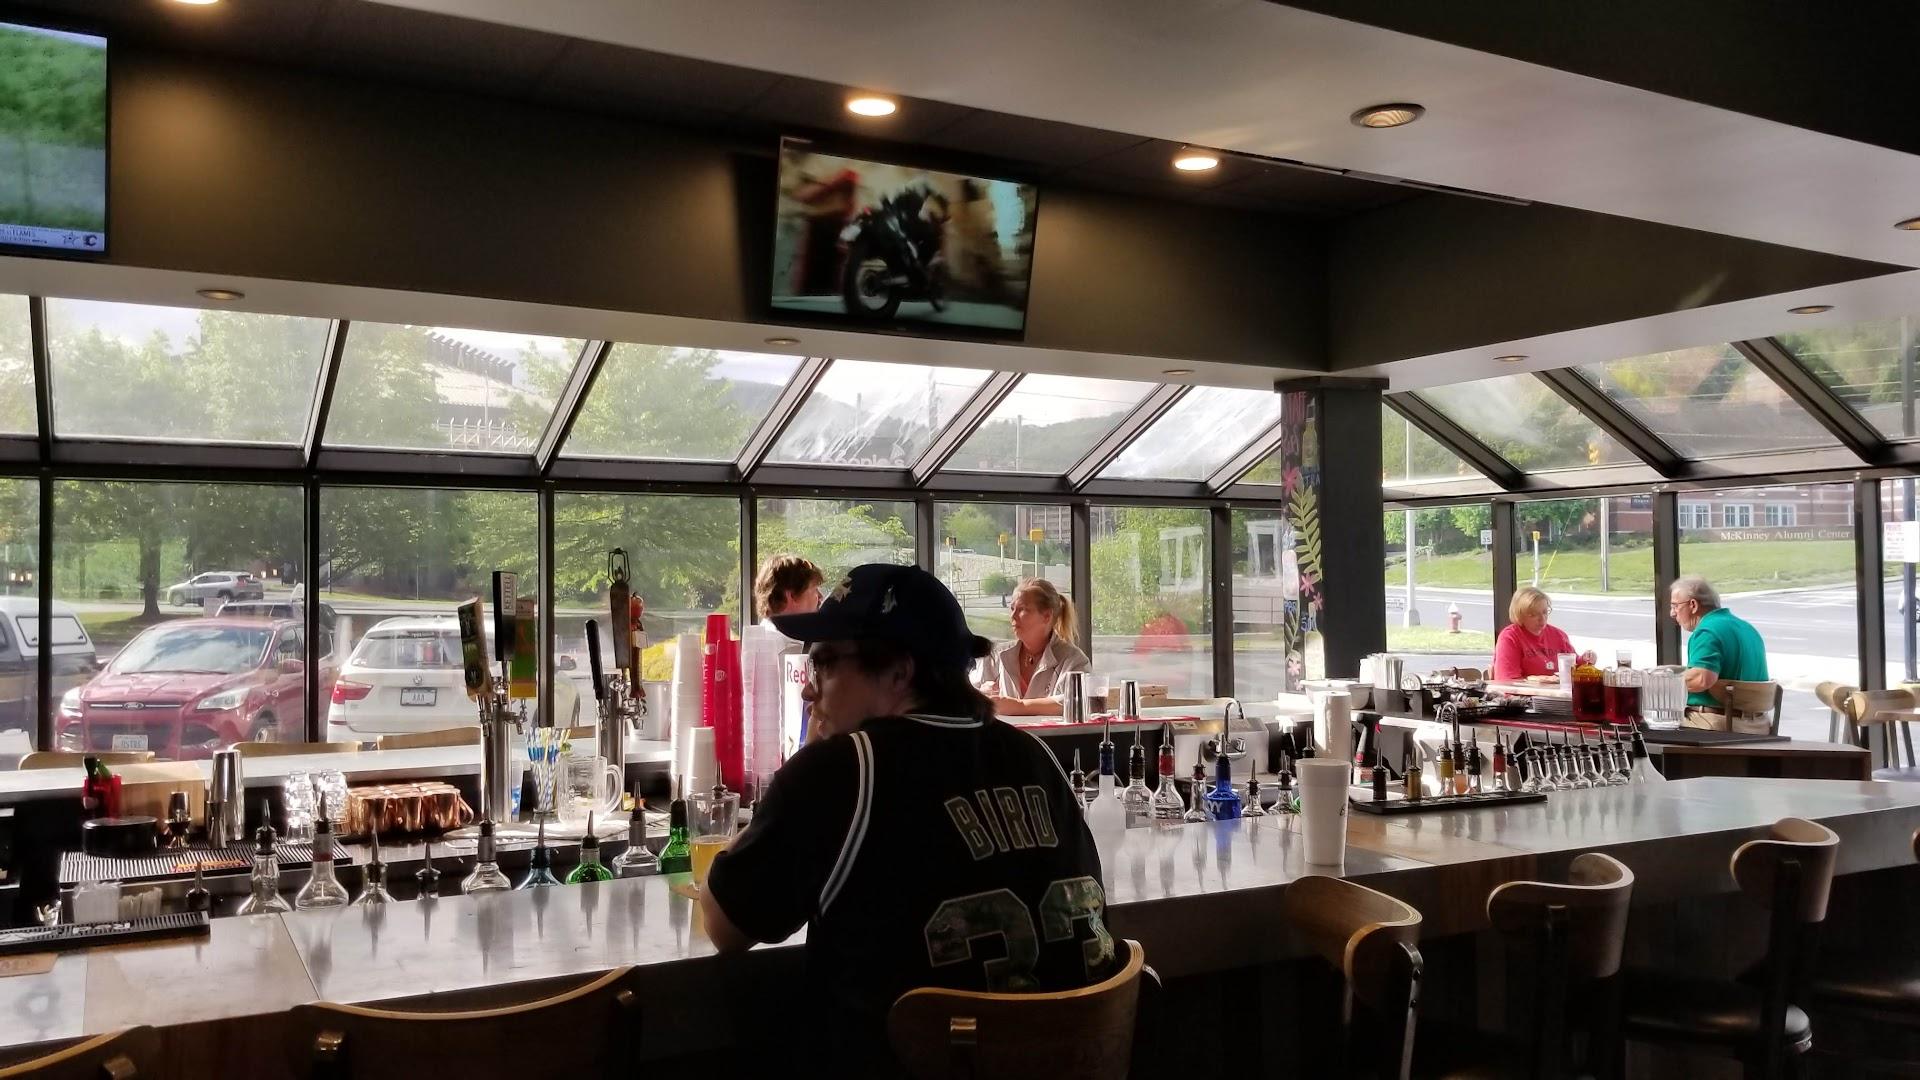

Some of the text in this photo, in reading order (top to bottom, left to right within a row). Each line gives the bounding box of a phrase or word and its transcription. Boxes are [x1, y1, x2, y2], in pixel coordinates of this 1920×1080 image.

[1720, 529, 1850, 541] McKinney Alumni Center
[944, 785, 1059, 861] BIRD
[924, 876, 1115, 993] 33
